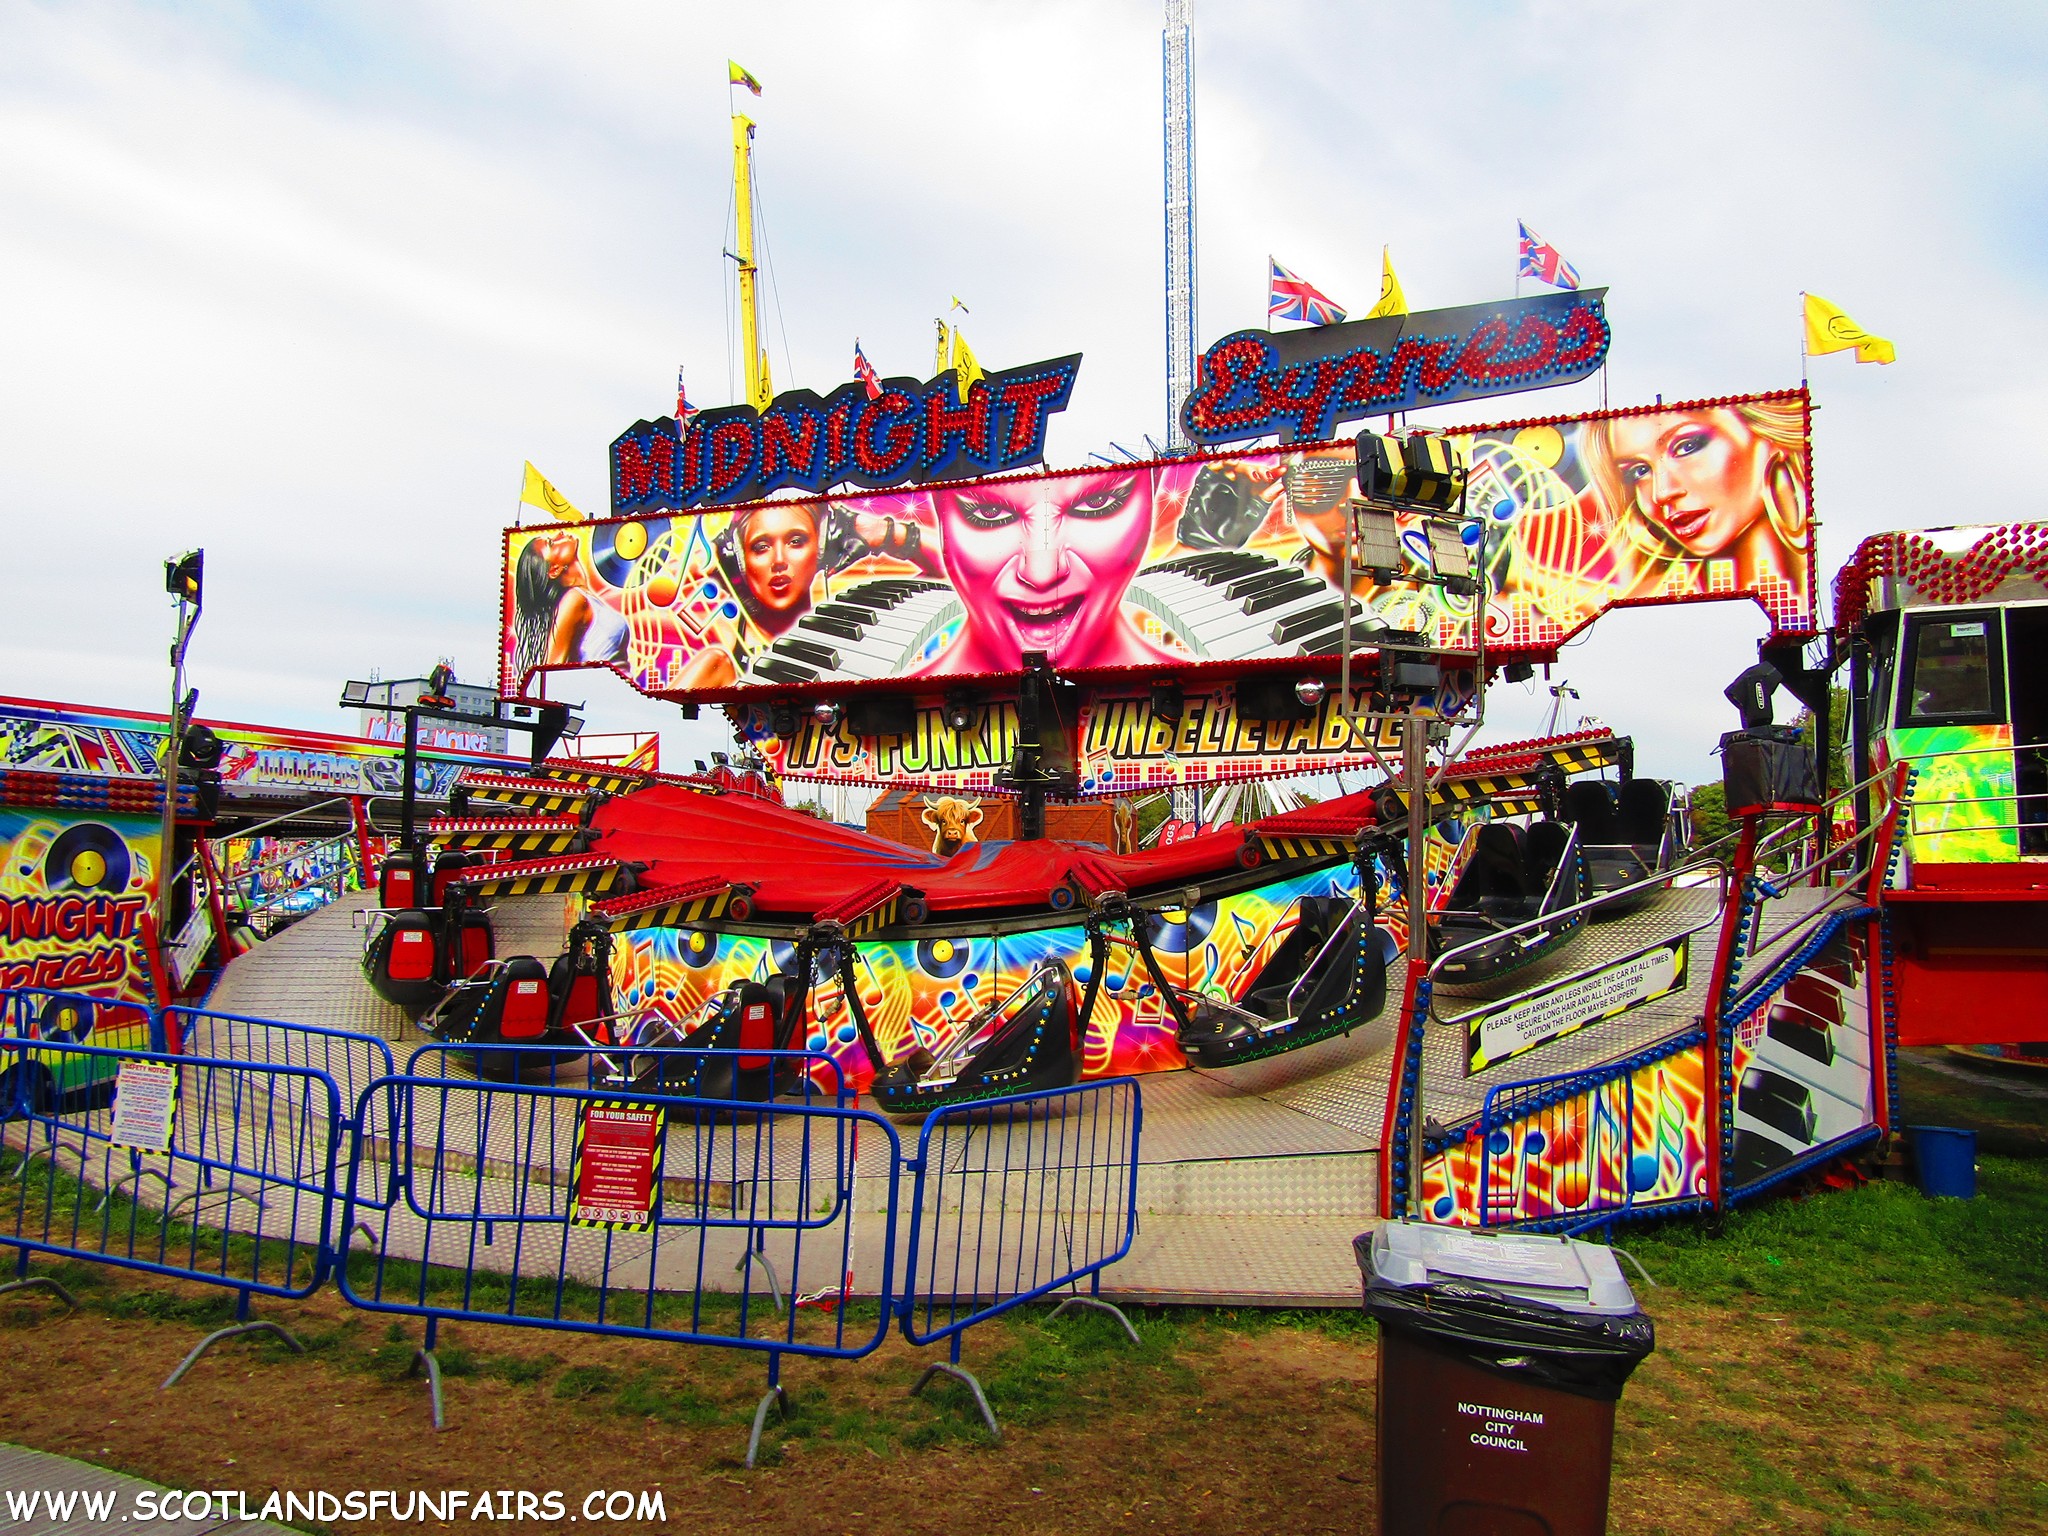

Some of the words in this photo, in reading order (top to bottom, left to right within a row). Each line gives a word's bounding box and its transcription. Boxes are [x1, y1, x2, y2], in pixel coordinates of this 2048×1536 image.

[1187, 299, 1611, 440] Express
[616, 366, 1071, 506] MIDNIGHT
[258, 750, 360, 789] DODGEMS
[1486, 1015, 1512, 1031] PLEASE
[1513, 1008, 1531, 1021] KEEP
[1531, 1000, 1550, 1014] ARMS
[1550, 994, 1564, 1007] AND
[1565, 987, 1581, 1001] LEGS
[1582, 979, 1601, 993] INSIDE
[1603, 975, 1615, 985] THE
[1616, 968, 1629, 979] CAR
[1630, 965, 1638, 974] AT
[1638, 961, 1649, 971] ALL
[1651, 953, 1669, 966] TIMES
[1516, 1016, 1541, 1031] SECURE
[1542, 1007, 1561, 1021] LONG
[1561, 1000, 1576, 1013] HAIR
[1577, 994, 1590, 1006] AND
[1591, 990, 1603, 1001] ALL
[1604, 981, 1624, 996] LOOSE
[1625, 974, 1643, 986] ITEMS
[1523, 1023, 1551, 1040] CAUTION
[1552, 1016, 1564, 1028] THE
[1565, 1008, 1586, 1023] FLOOR
[1587, 999, 1608, 1013] MAYBE
[1609, 987, 1638, 1005] SLIPPERY
[1215, 1022, 1224, 1033] 3
[148, 1066, 170, 1075] NOTICE
[888, 1067, 899, 1078] 2
[590, 1110, 605, 1119] FOR
[605, 1111, 625, 1120] YOUR
[626, 1112, 654, 1122] SAFETY
[1457, 1402, 1544, 1424] NOTTINGHAM
[1485, 1421, 1514, 1435] CITY
[1470, 1433, 1528, 1451] COUNCIL
